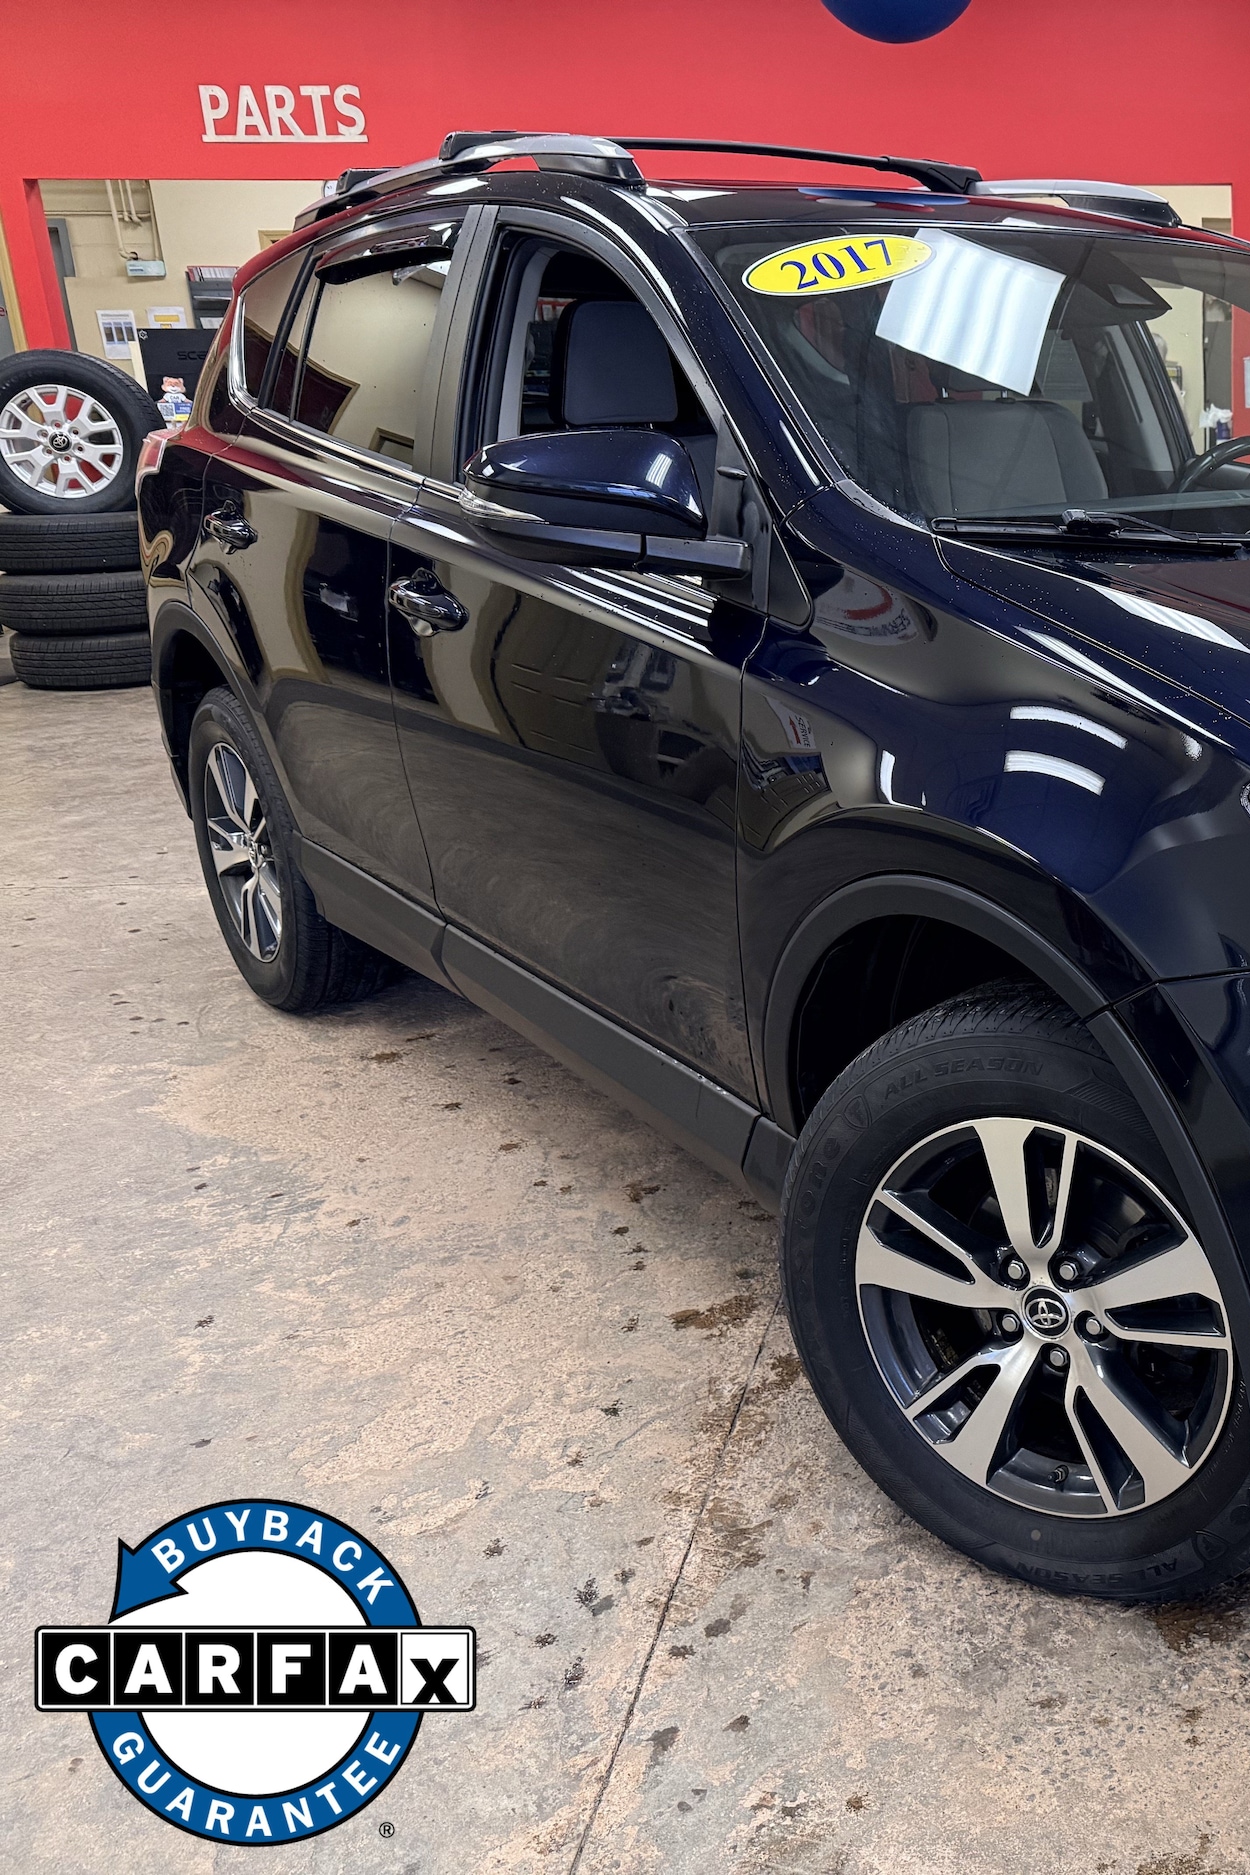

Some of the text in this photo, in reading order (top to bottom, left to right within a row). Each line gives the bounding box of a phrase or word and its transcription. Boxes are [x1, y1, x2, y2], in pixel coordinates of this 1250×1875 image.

[198, 84, 367, 142] PARTS
[781, 239, 892, 290] 2017
[885, 1057, 1045, 1099] ALL SEASON
[1016, 1561, 1124, 1585] SEASON
